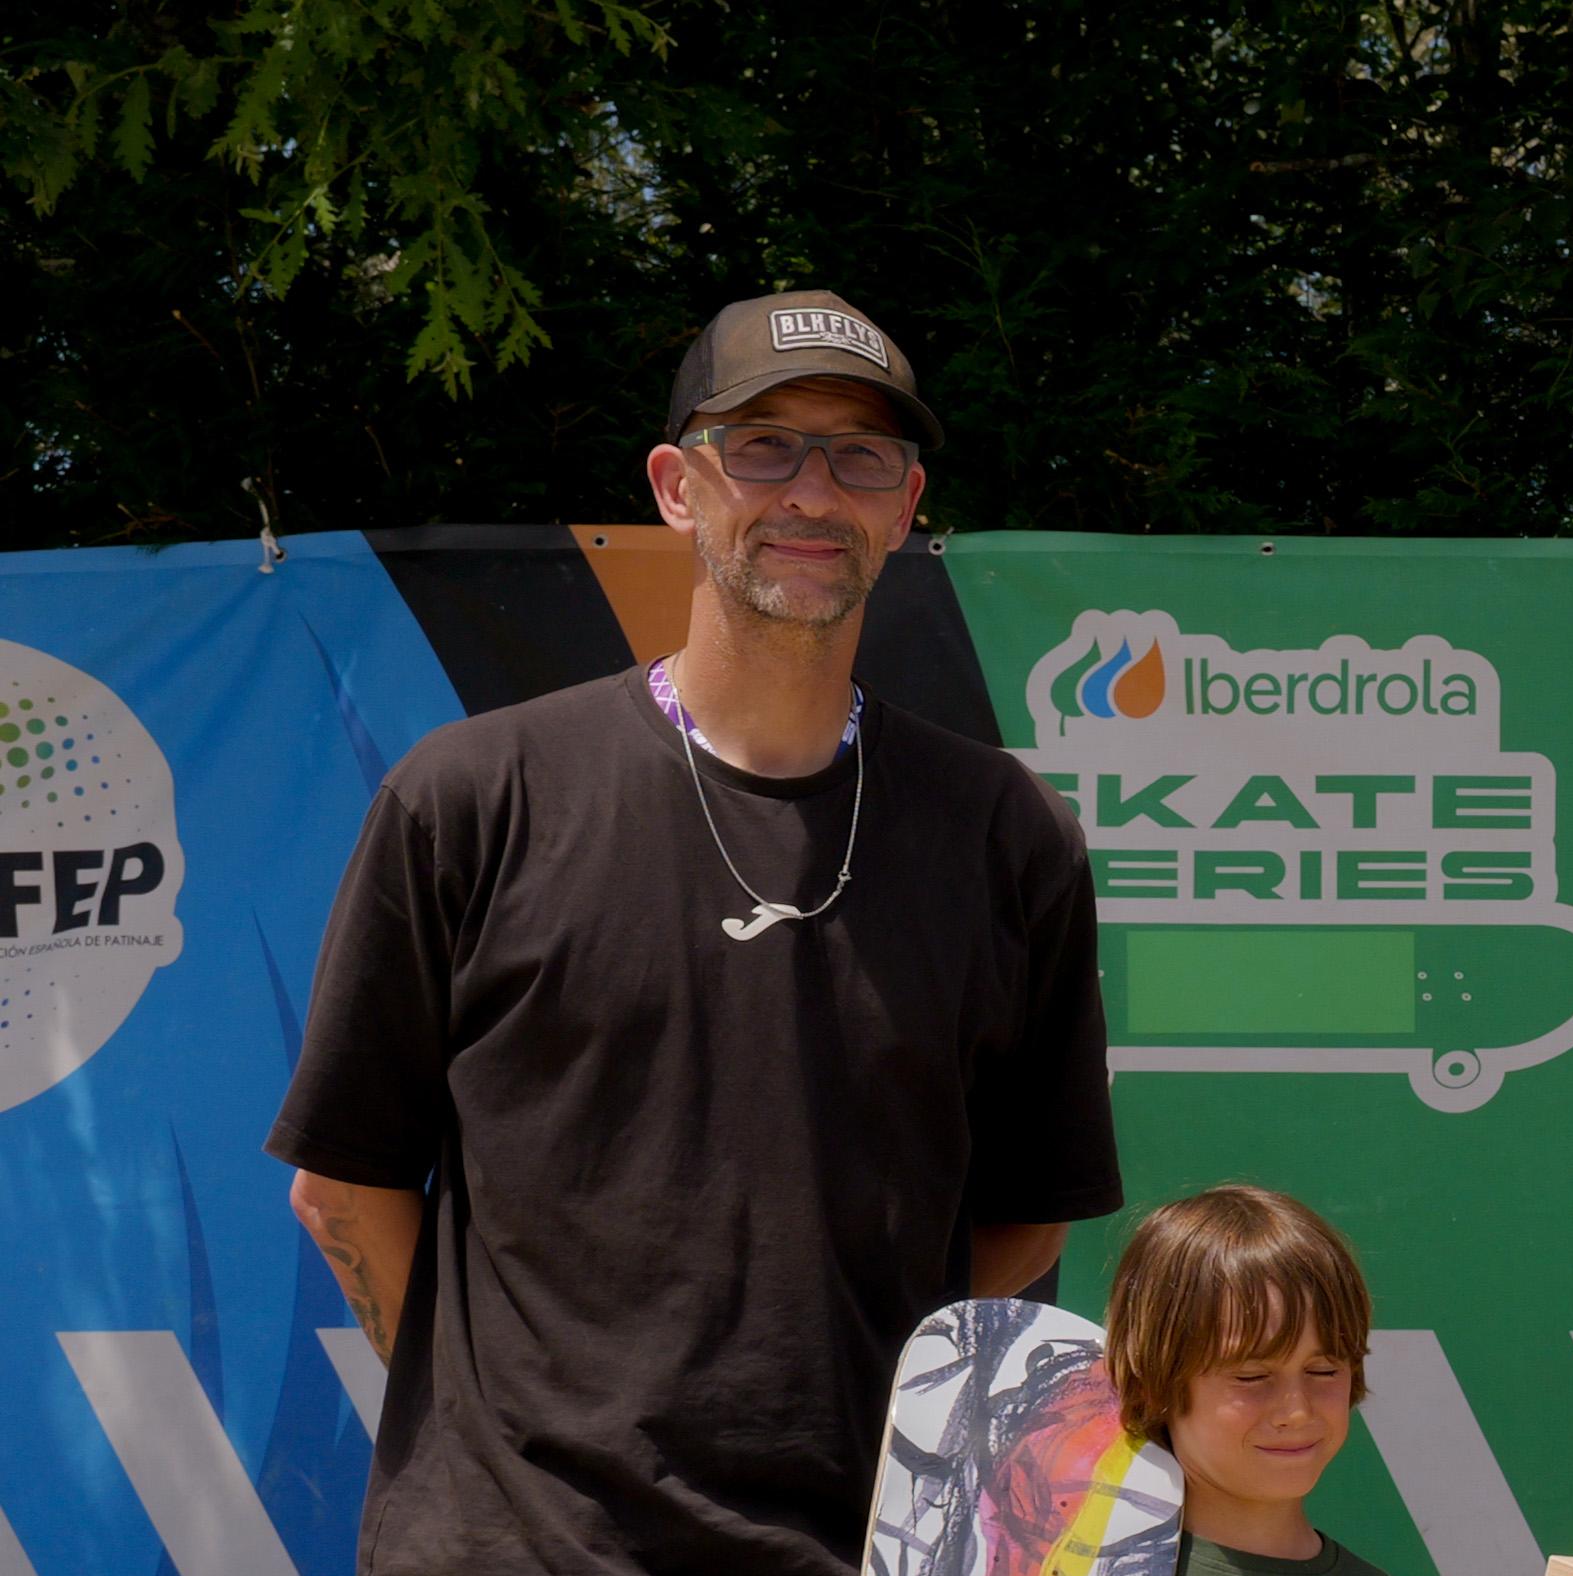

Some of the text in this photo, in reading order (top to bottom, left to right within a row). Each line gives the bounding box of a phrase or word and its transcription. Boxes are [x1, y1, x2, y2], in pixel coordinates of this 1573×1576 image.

[1184, 658, 1478, 716] Iberdrola
[1090, 850, 1534, 900] ERIES
[85, 936, 100, 946] DE
[105, 935, 164, 946] PATINAJE
